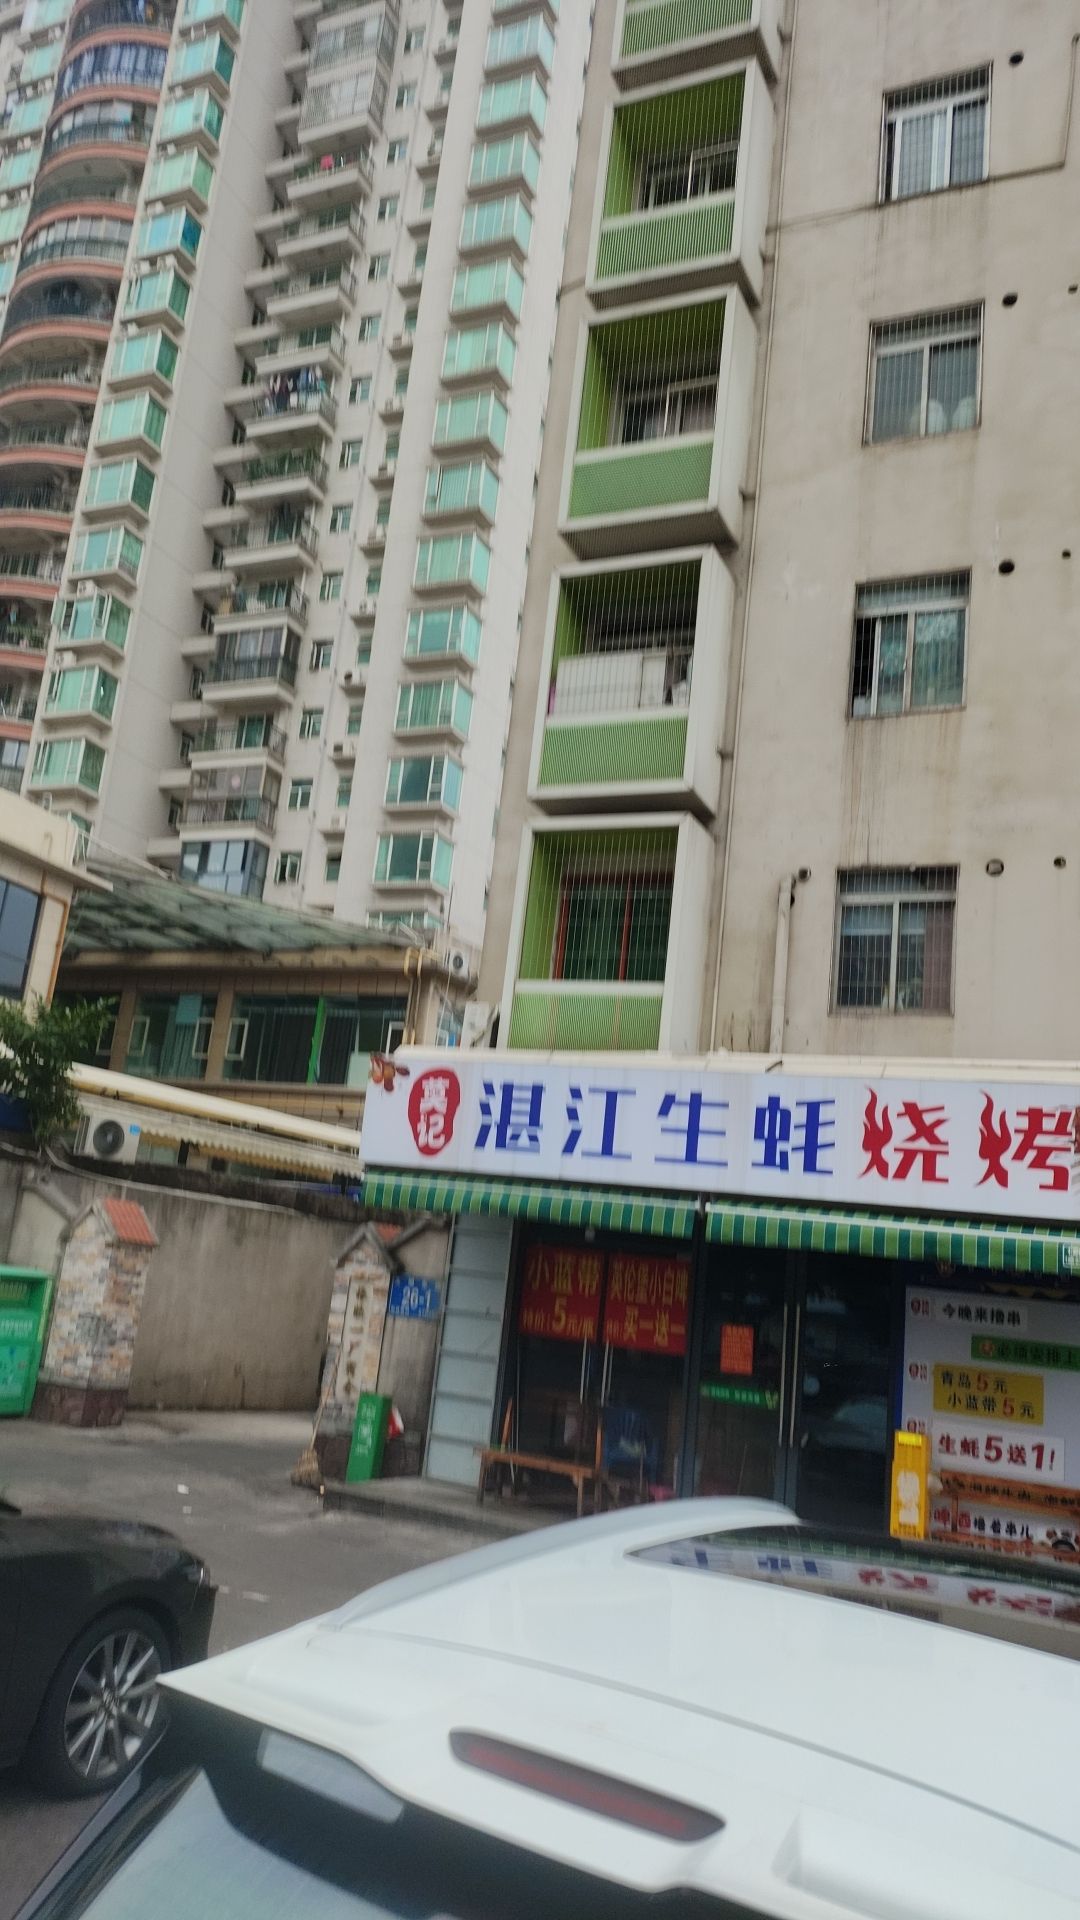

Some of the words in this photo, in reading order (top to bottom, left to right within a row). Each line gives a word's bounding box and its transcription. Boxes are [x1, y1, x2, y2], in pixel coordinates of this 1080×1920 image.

[474, 1079, 1074, 1191] 湛江生蚝烧烤
[527, 1250, 600, 1298] 小蓝带
[941, 1370, 1008, 1395] 青岛5元
[948, 1391, 1034, 1420] 小蓝带5元
[938, 1432, 1056, 1472] 生蚝5送1!
